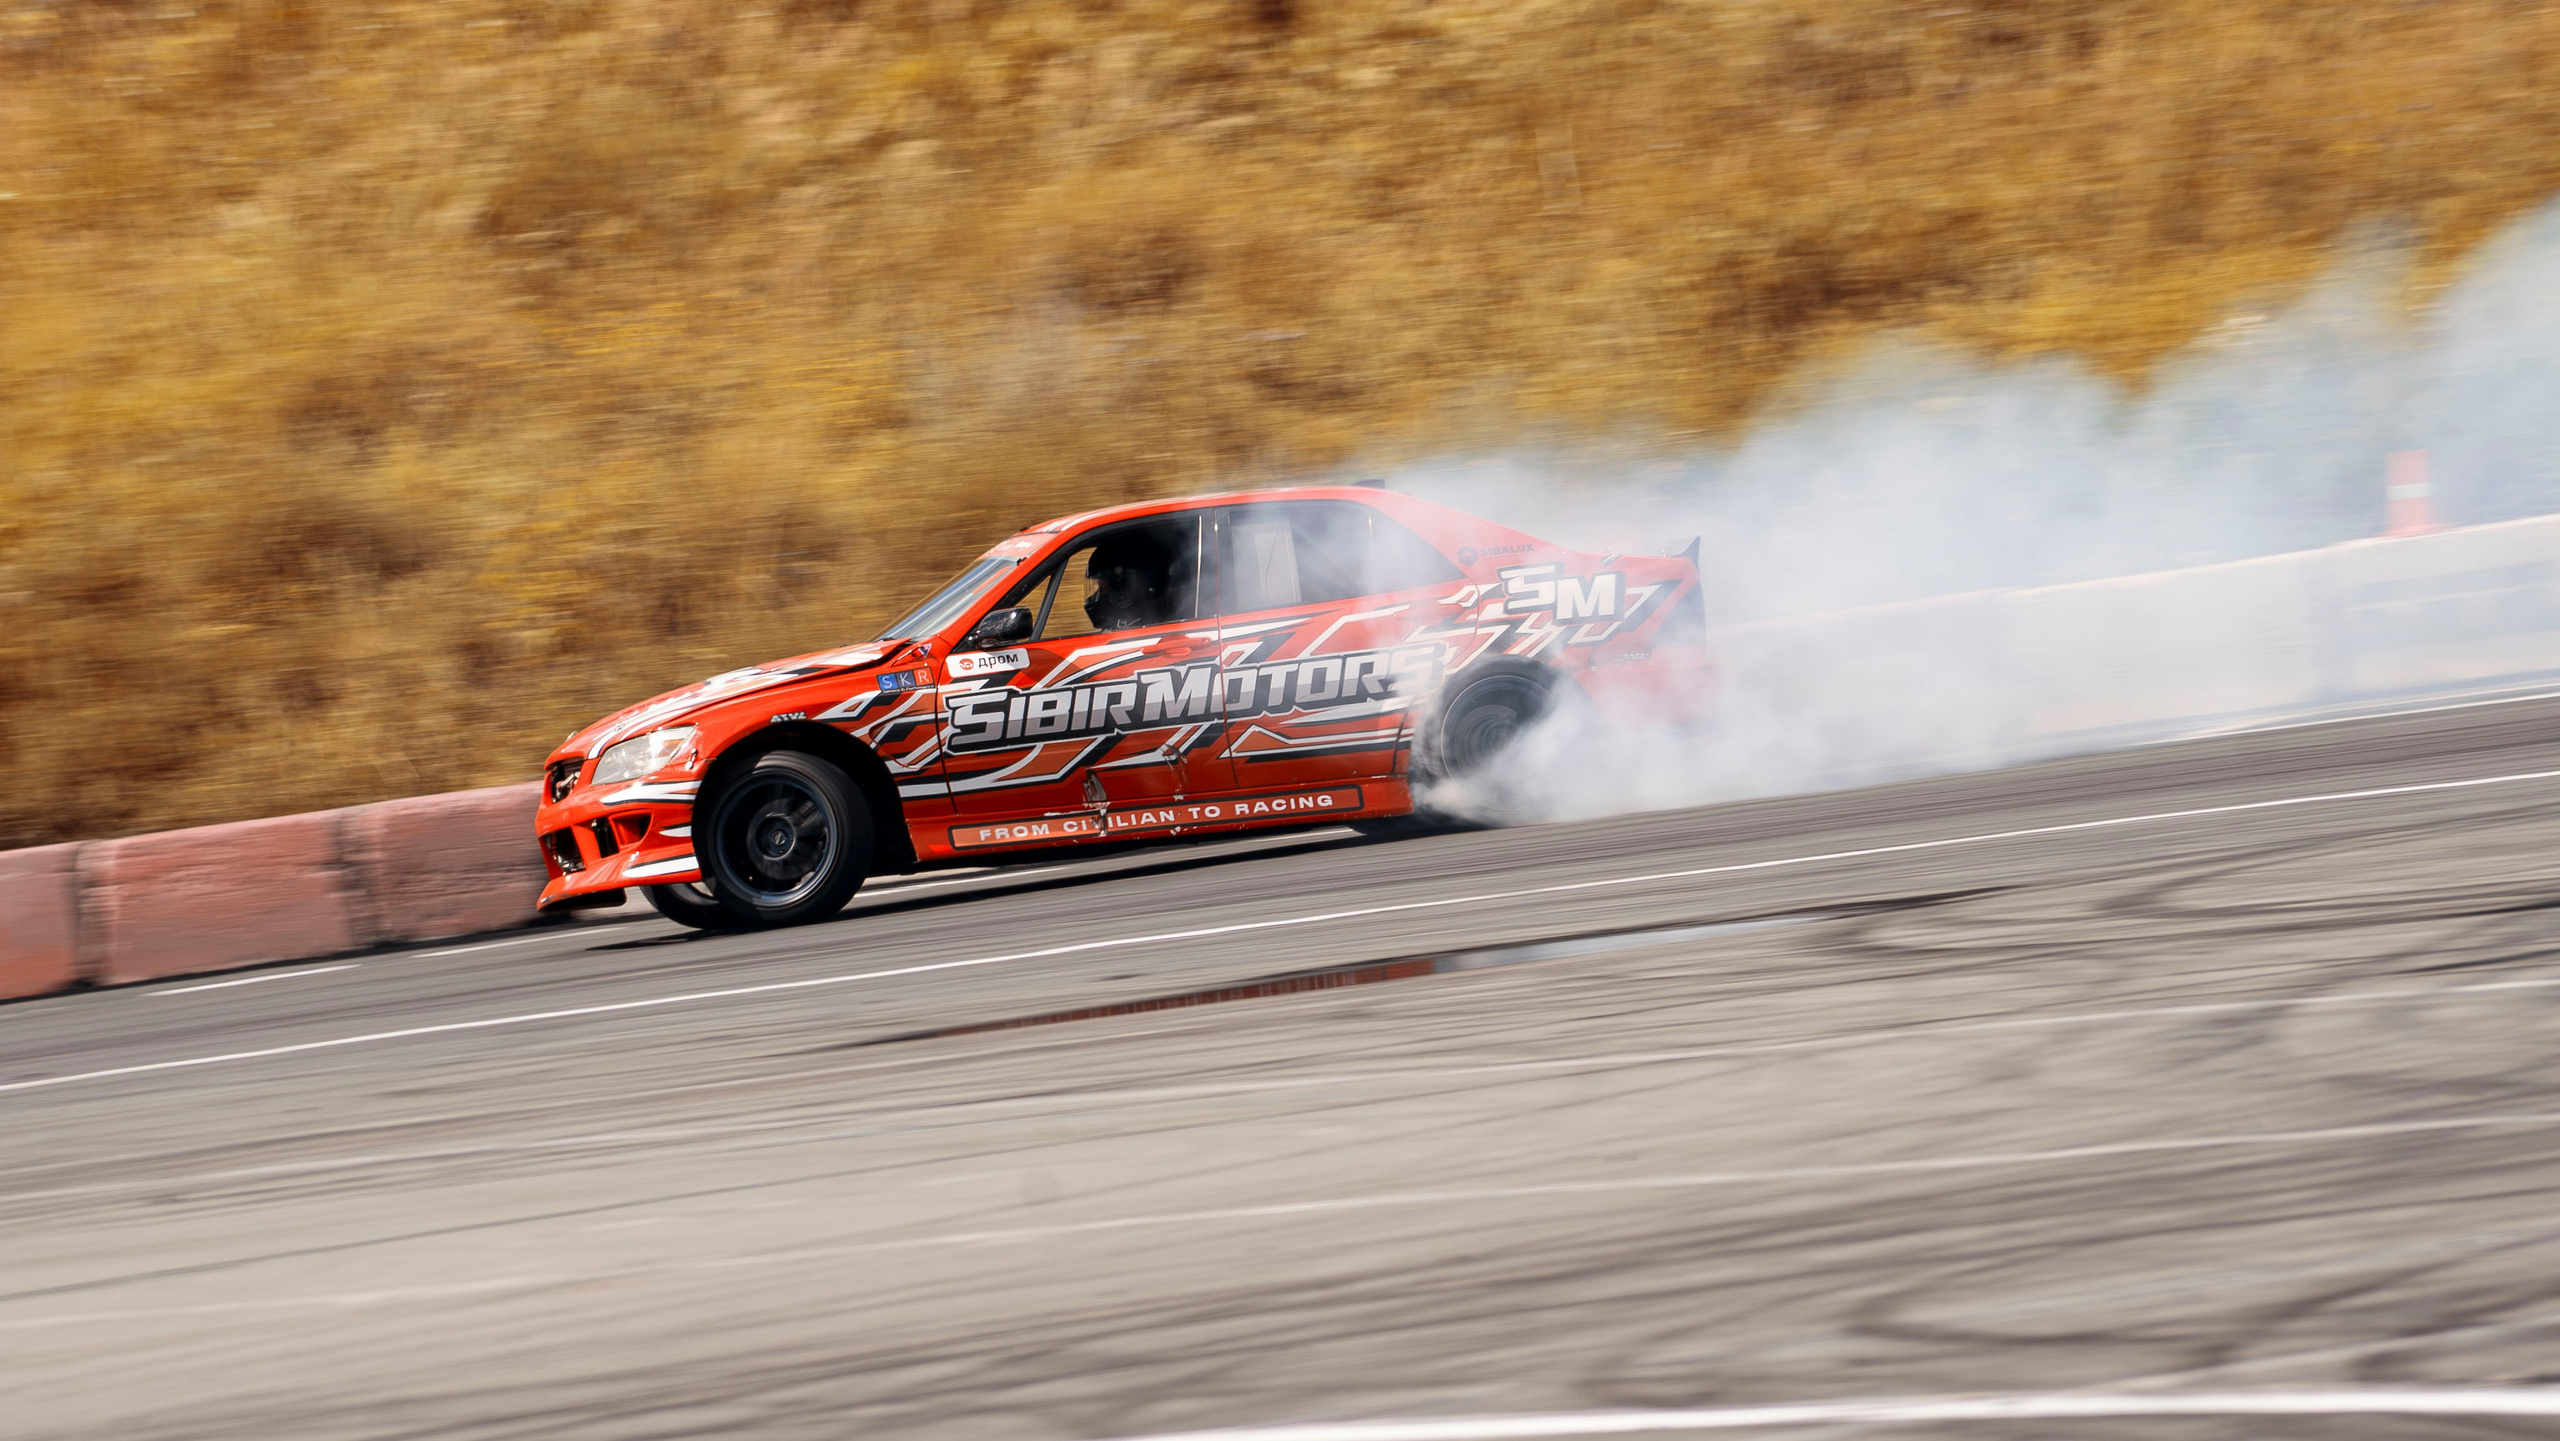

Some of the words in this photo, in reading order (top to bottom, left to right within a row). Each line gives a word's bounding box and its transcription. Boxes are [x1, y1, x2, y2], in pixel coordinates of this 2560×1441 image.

[1500, 564, 1617, 620] SM
[979, 823, 1050, 841] FROM
[1187, 805, 1221, 820] TO
[1234, 794, 1334, 816] RACING
